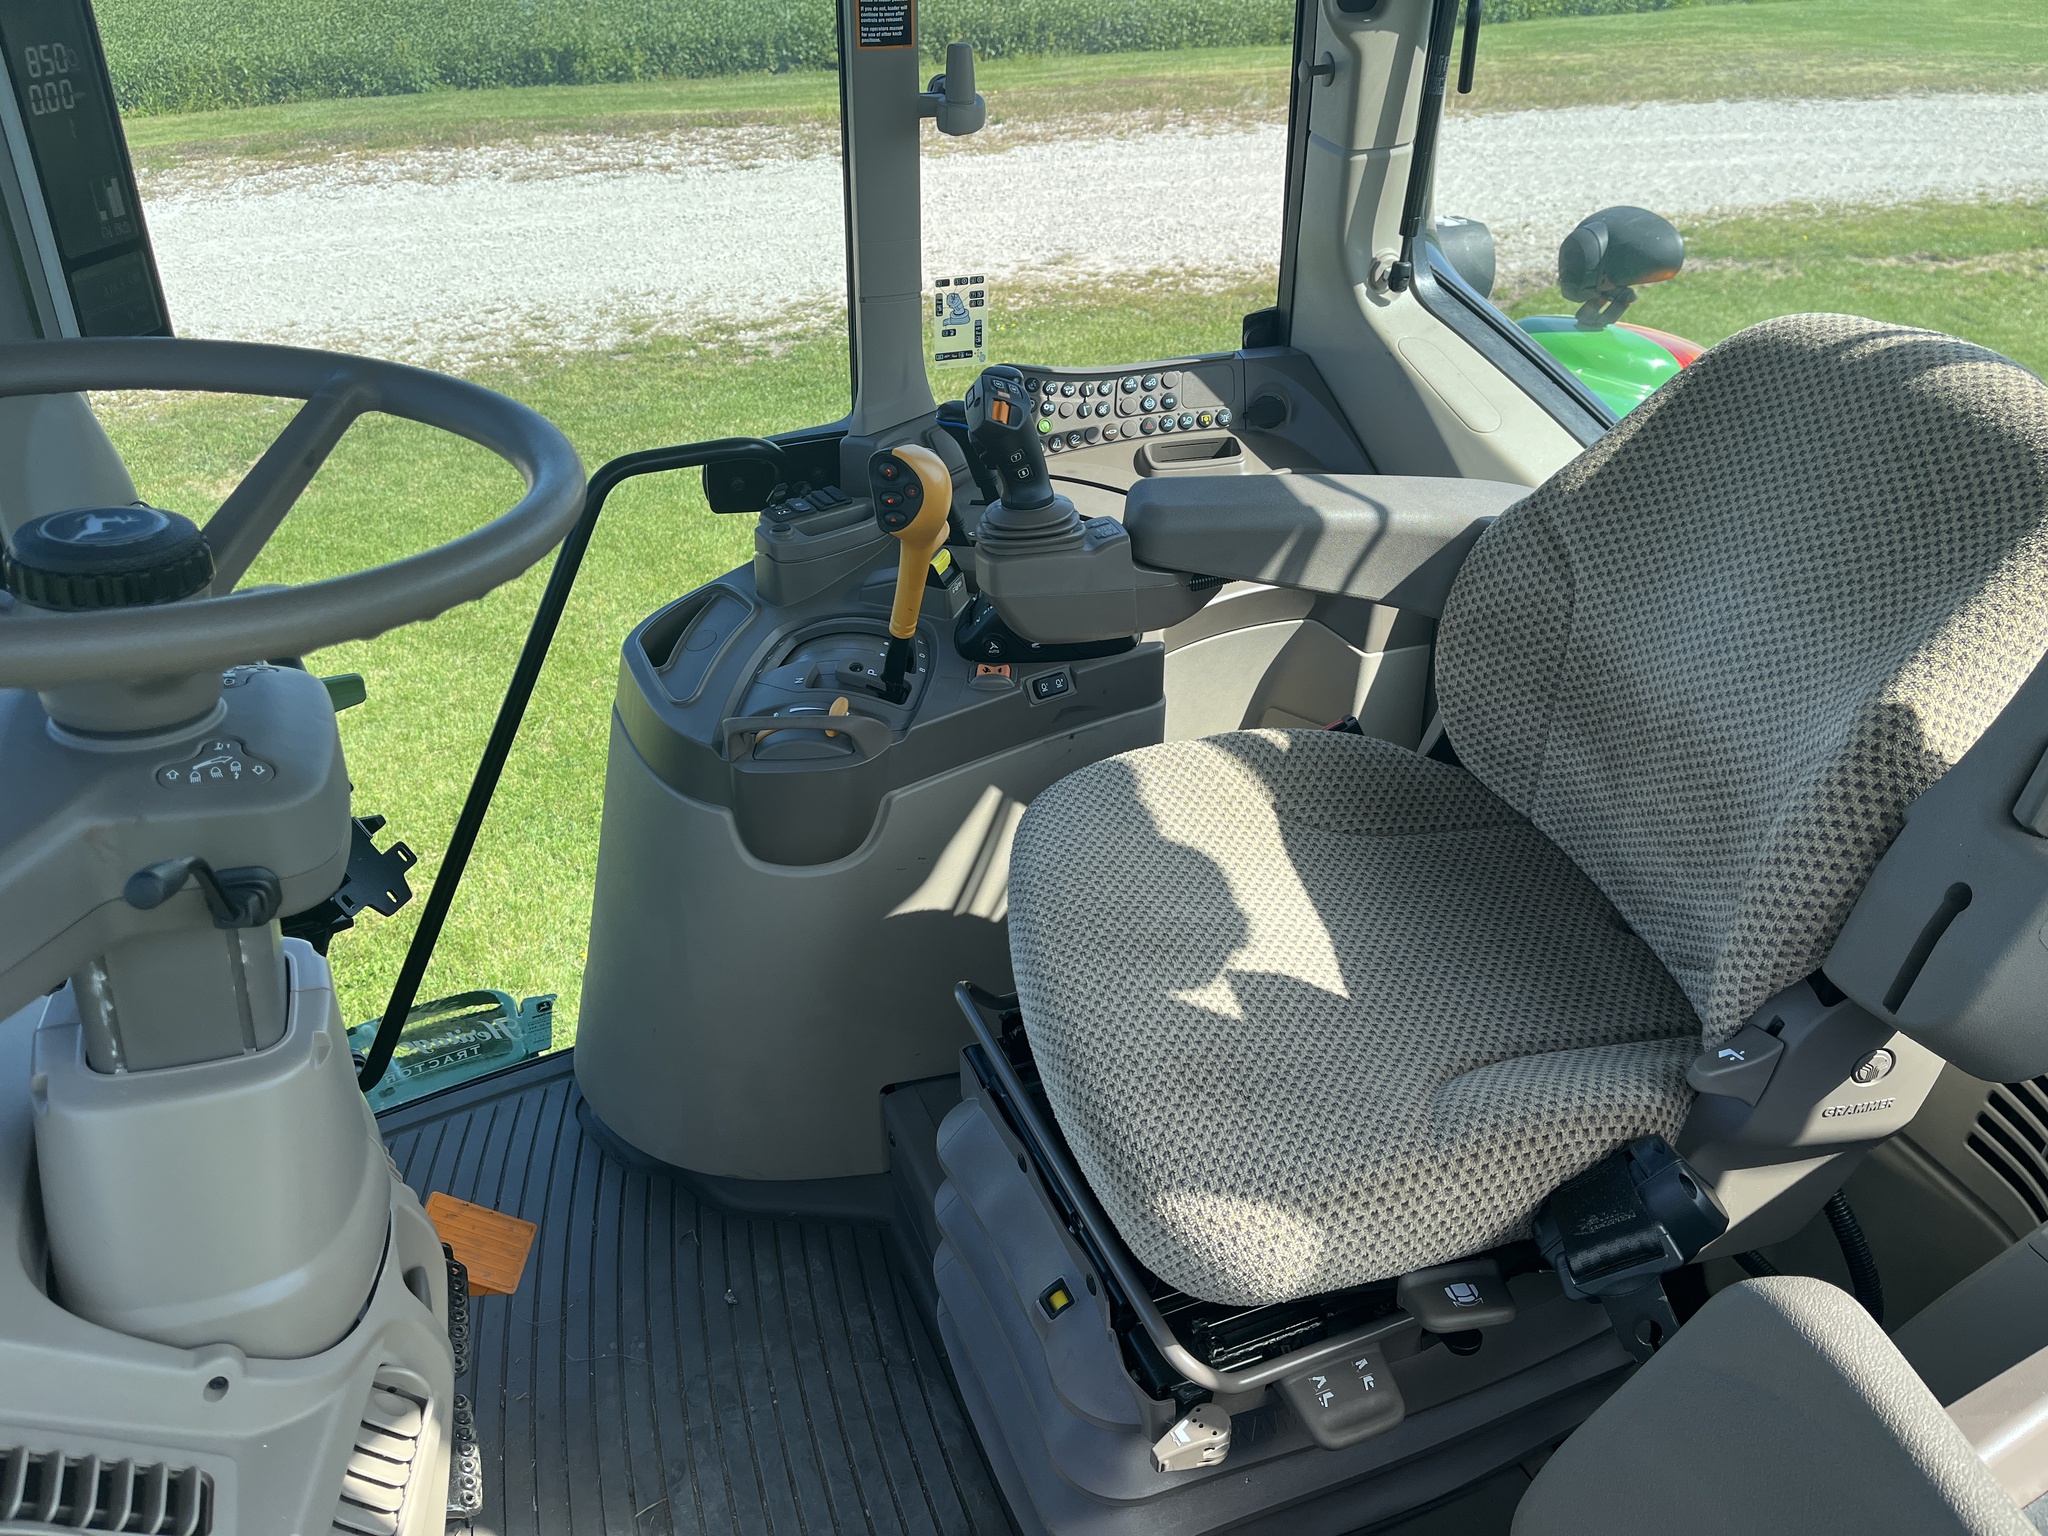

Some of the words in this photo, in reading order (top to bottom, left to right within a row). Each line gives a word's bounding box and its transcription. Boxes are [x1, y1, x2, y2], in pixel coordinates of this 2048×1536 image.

[29, 79, 75, 116] 0.00
[867, 668, 878, 677] P
[1821, 1097, 1896, 1118] GRAMMER
